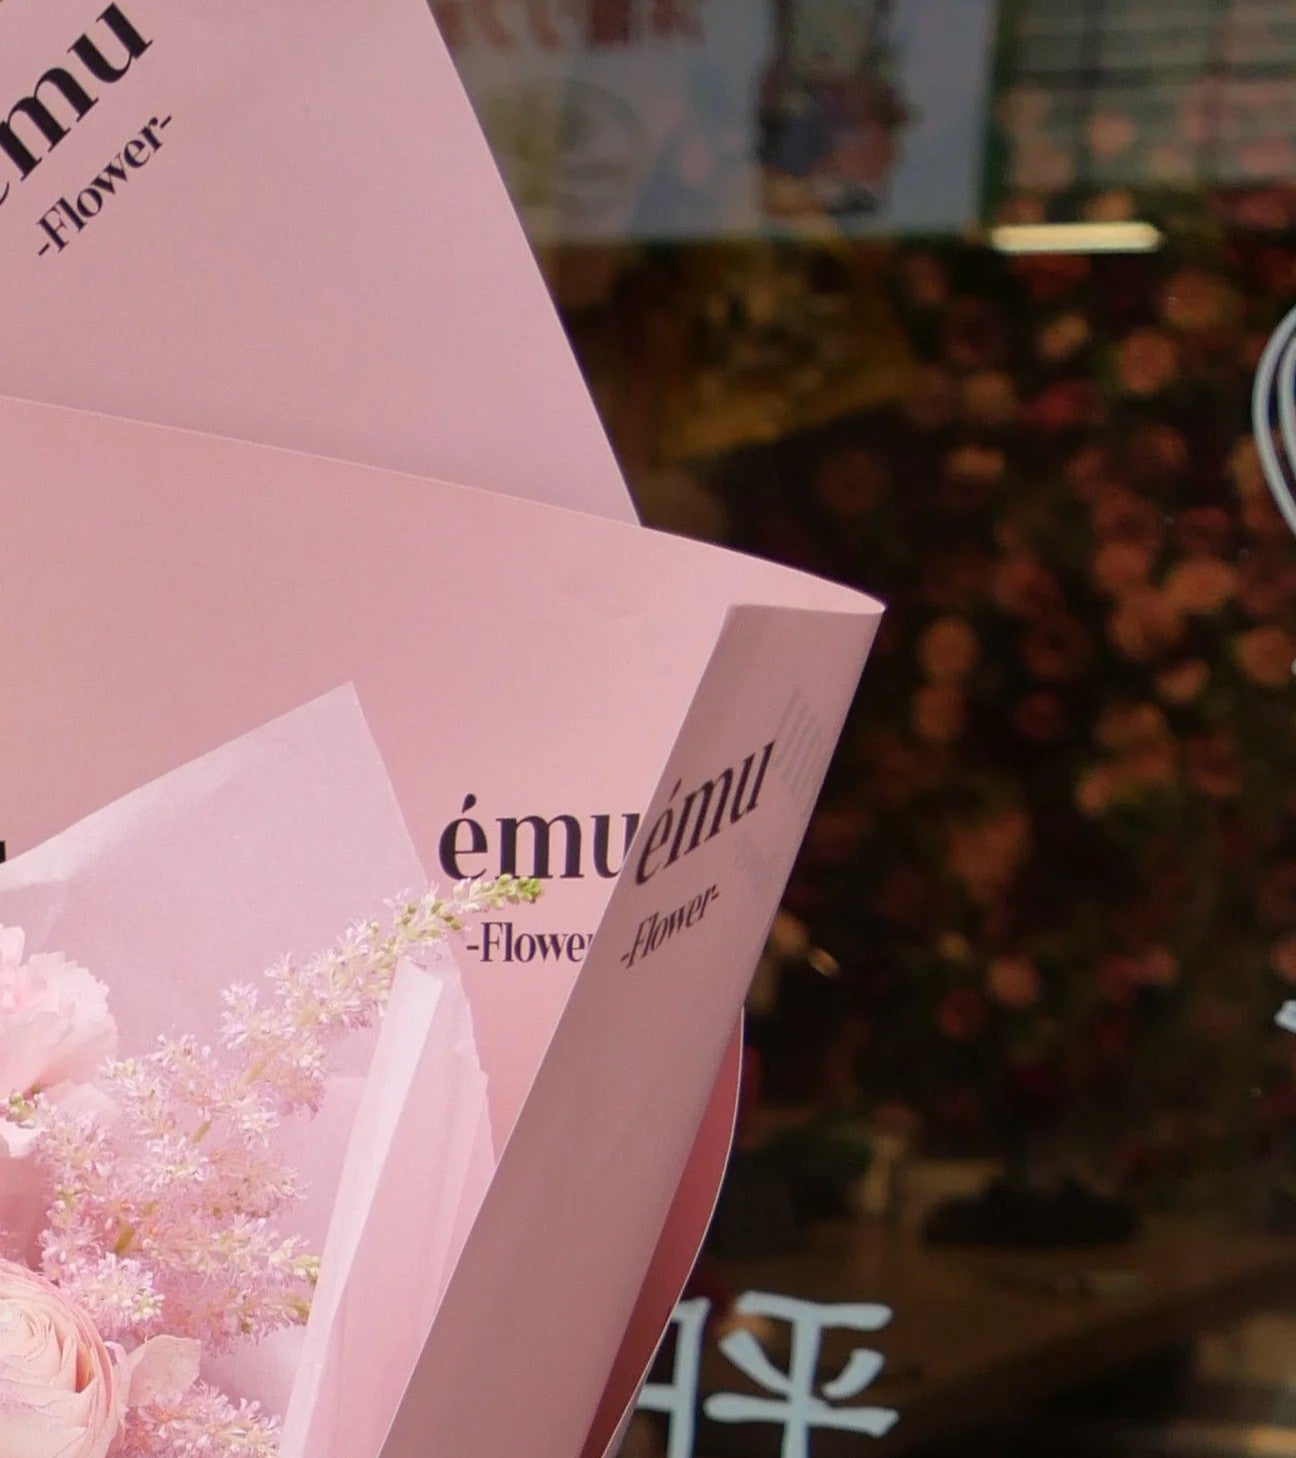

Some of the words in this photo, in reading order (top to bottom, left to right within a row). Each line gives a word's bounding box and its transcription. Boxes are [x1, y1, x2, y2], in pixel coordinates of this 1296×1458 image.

[36, 114, 172, 256] -Flower-
[438, 793, 640, 880] ému
[635, 741, 775, 886] ému
[619, 883, 720, 970] -Flower-
